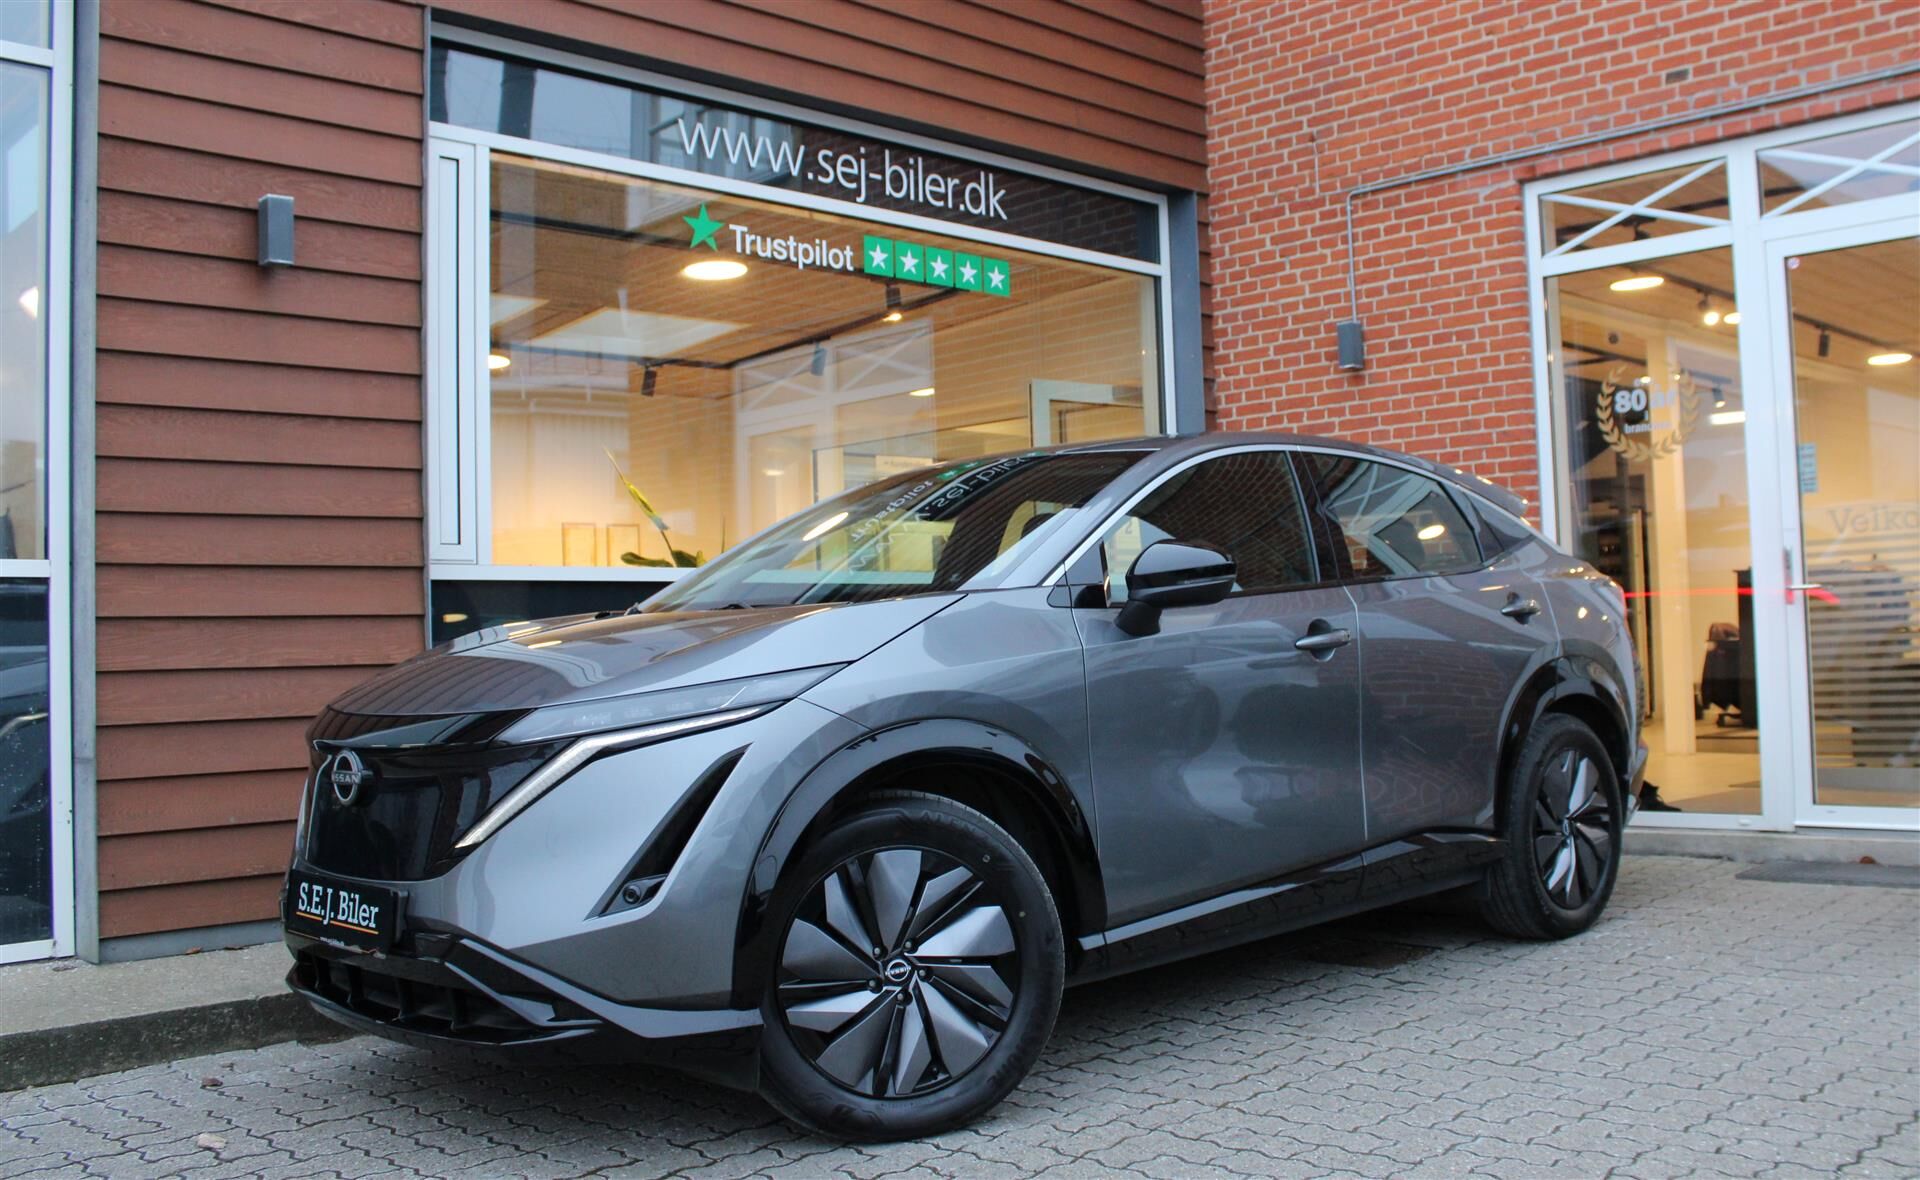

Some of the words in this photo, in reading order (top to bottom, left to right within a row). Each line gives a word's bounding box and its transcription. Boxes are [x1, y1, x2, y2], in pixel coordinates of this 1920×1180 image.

[678, 118, 1007, 220] www.sej-biler.dk
[728, 224, 854, 271] Trustpilot
[1614, 388, 1646, 414] 80
[298, 882, 334, 924] S.E.J.
[336, 890, 379, 928] Biler
